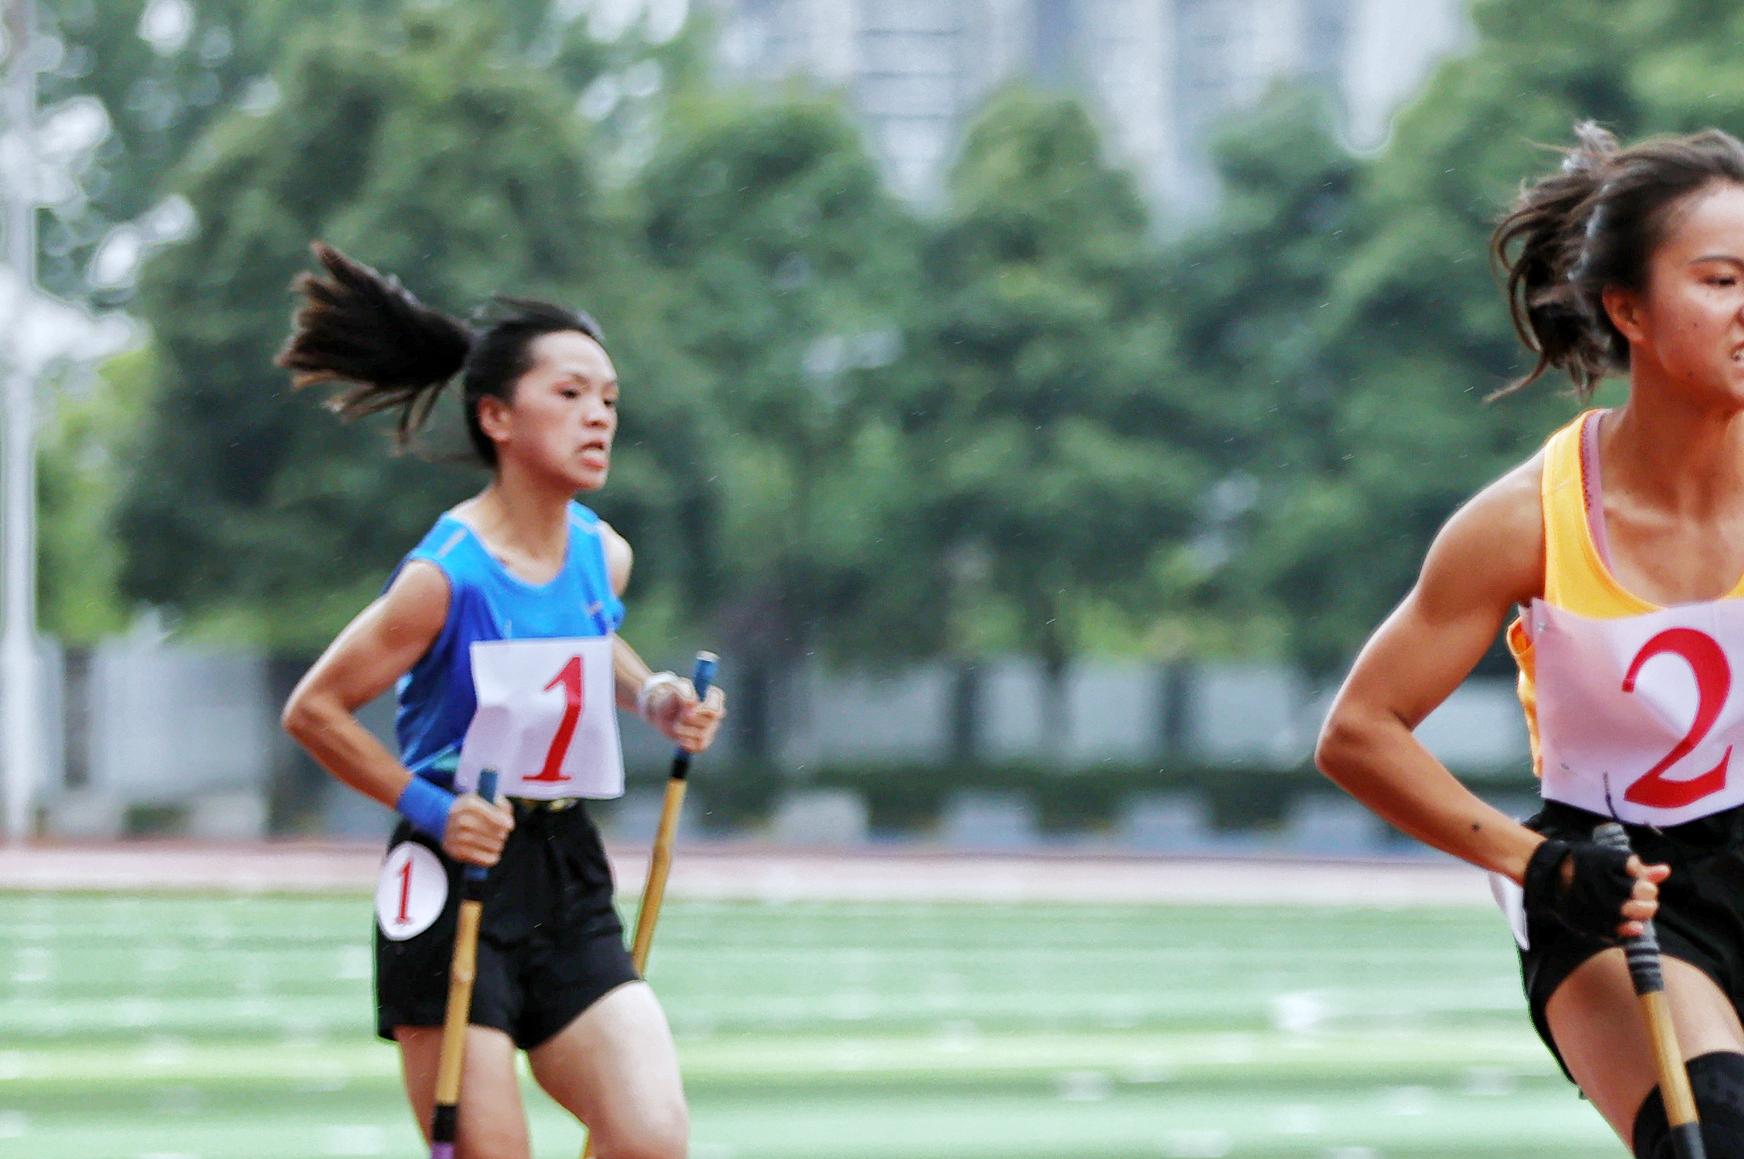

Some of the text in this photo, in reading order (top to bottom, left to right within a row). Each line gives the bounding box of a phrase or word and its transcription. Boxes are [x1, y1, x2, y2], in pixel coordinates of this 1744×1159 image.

[521, 654, 584, 782] 1
[1621, 626, 1733, 809] 2
[394, 856, 413, 926] 1
